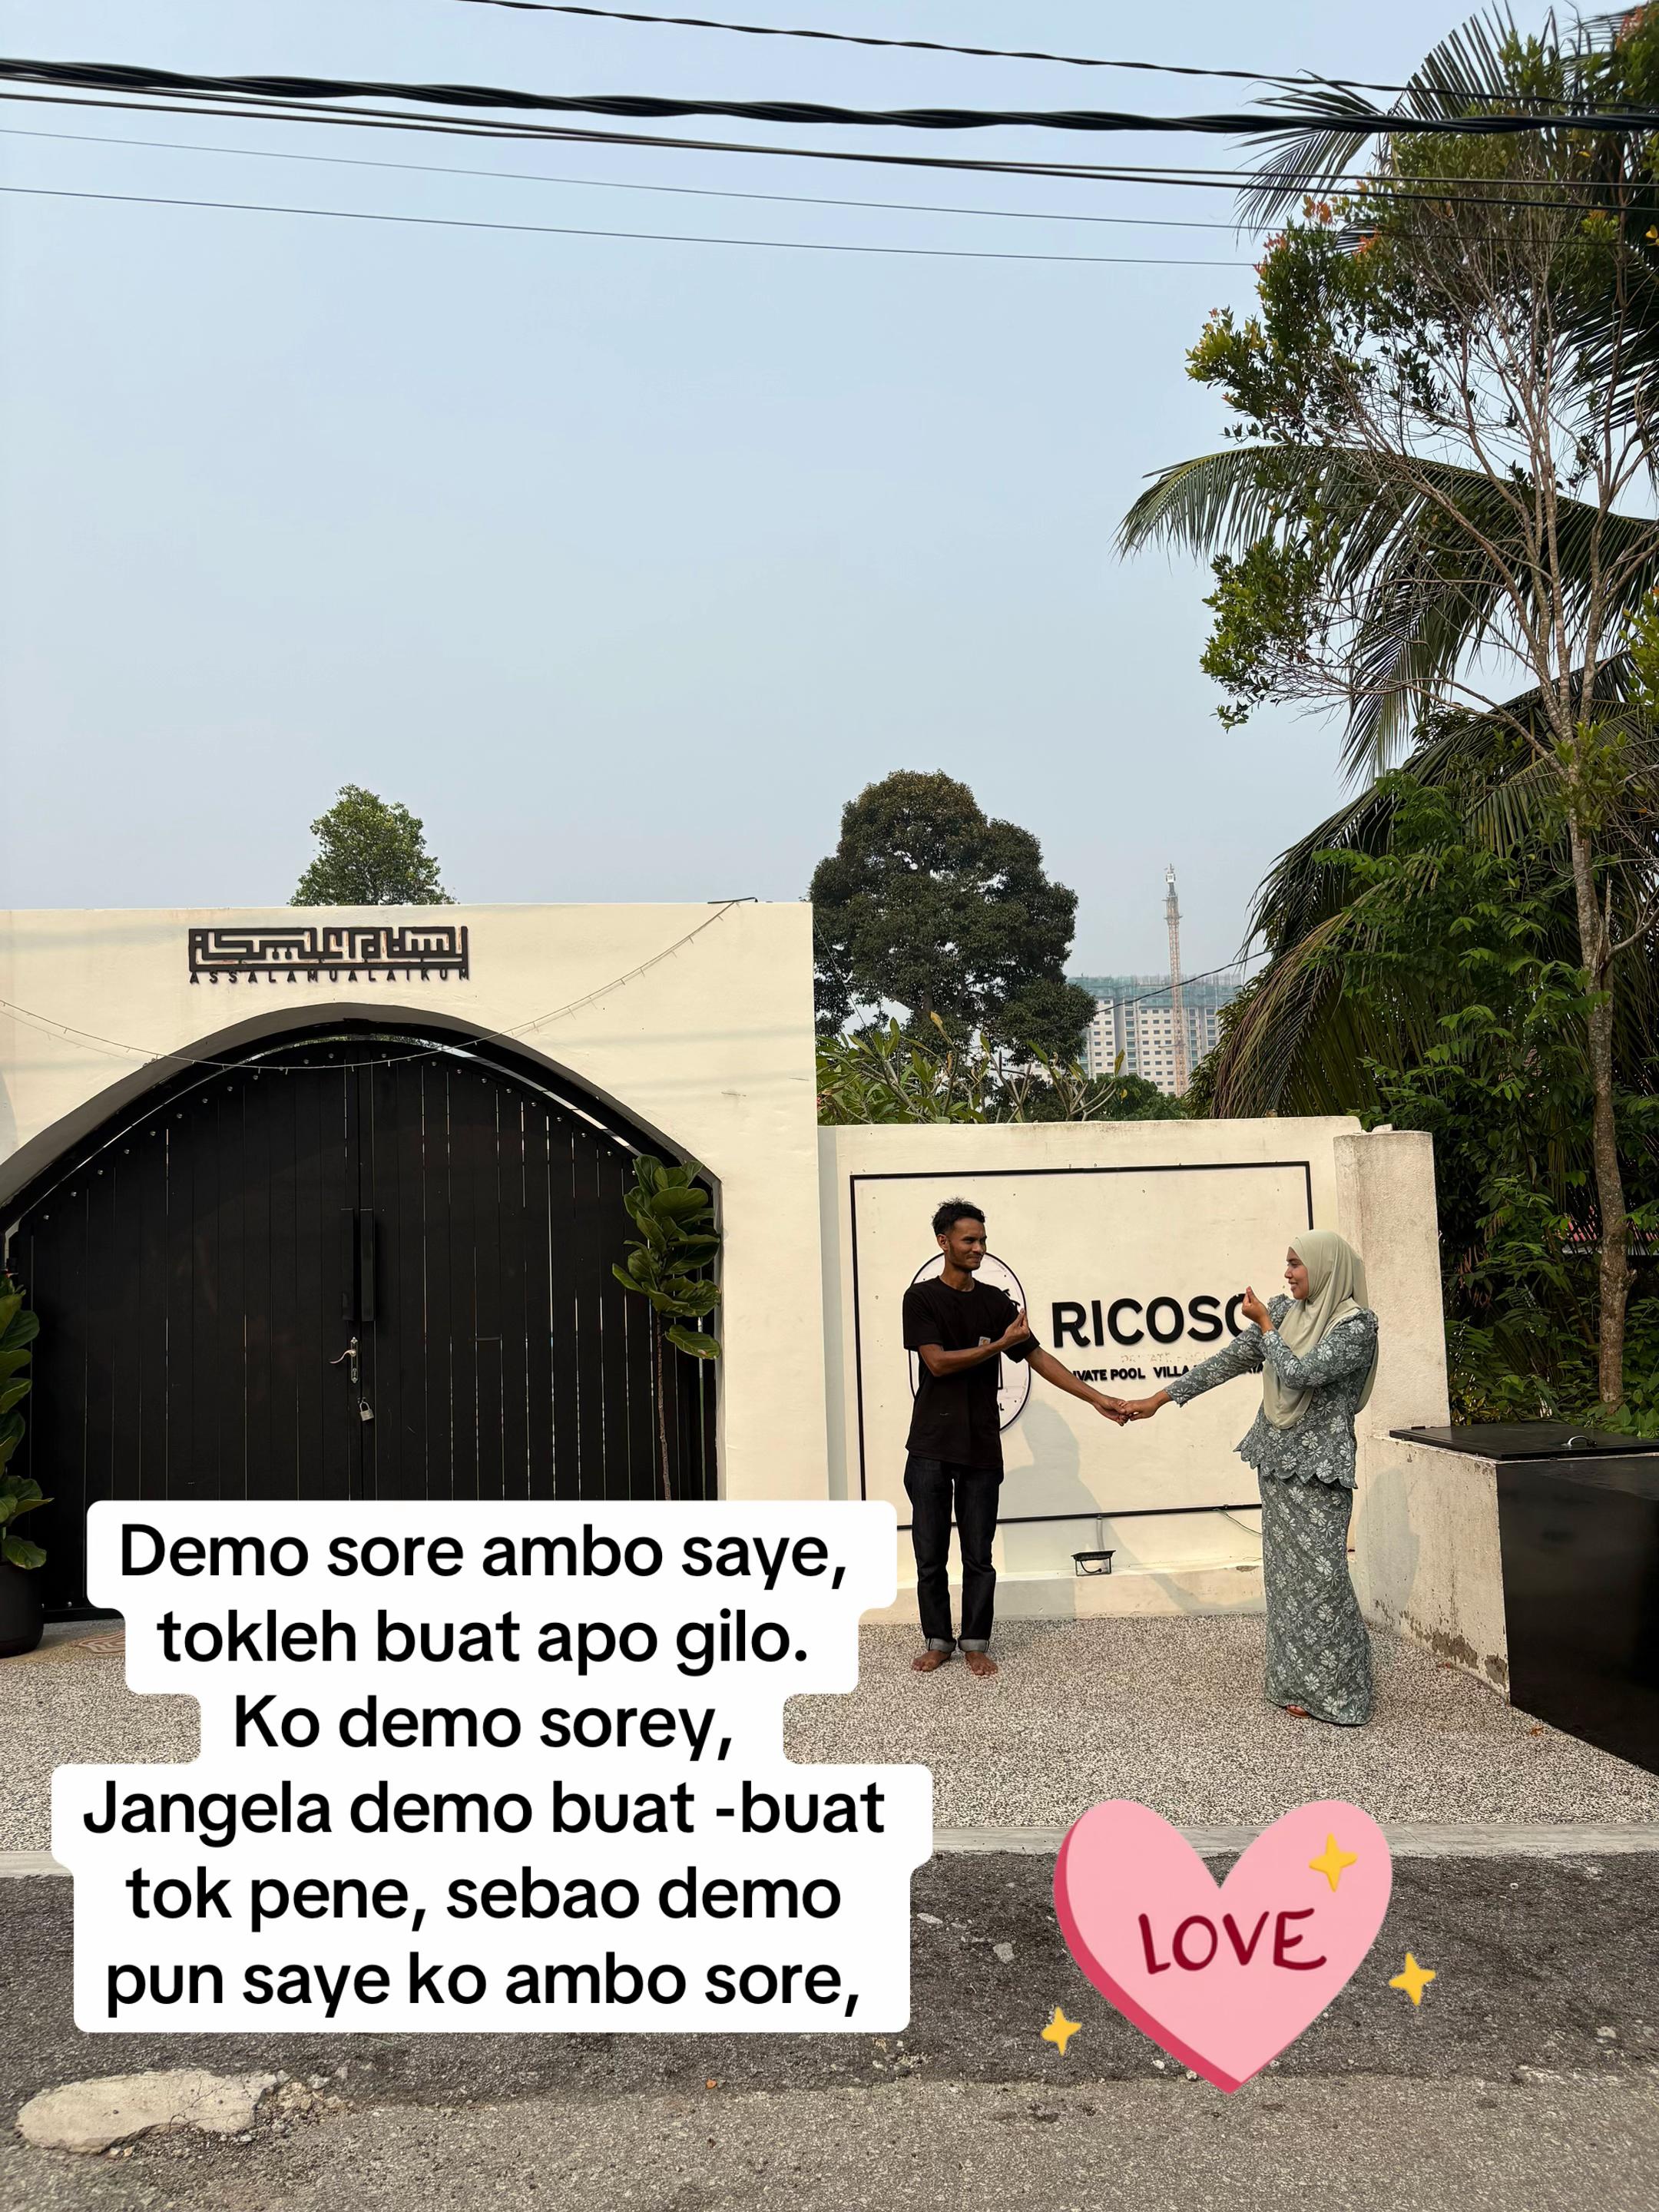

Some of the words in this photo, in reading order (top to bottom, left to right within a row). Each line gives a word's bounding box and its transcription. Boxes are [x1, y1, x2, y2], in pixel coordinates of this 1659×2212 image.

[189, 969, 469, 984] ASSALAMUALAIKUM
[1072, 1369, 1108, 1382] IVATE
[1111, 1367, 1146, 1380] POOL
